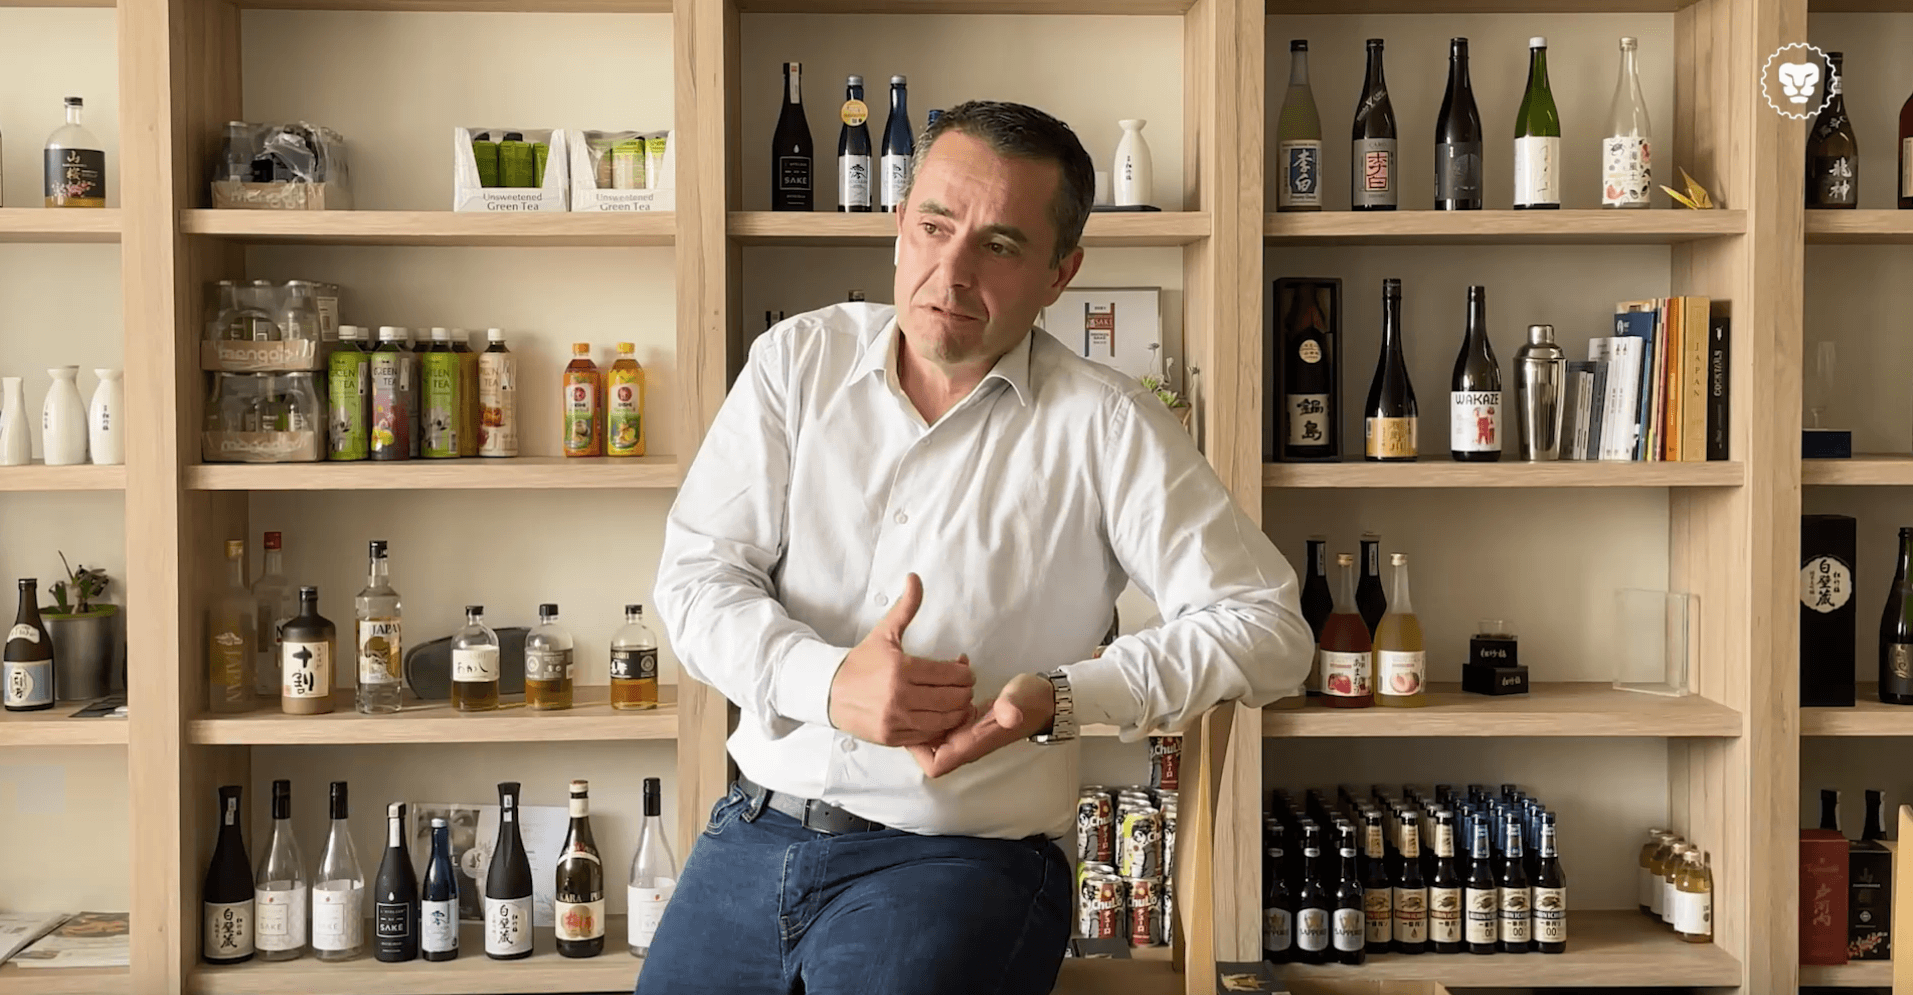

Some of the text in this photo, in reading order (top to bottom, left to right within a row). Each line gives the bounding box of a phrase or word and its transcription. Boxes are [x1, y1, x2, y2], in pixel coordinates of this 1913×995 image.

[483, 193, 543, 201] Unsweetened
[596, 193, 654, 201] Unsweetened
[487, 202, 539, 211] Green Tea
[600, 202, 650, 211] Green Tea
[1693, 342, 1701, 397] JAPAN
[1713, 350, 1723, 397] COCKTAILS
[1456, 393, 1499, 405] WAKAZE
[1154, 743, 1182, 756] ChuL
